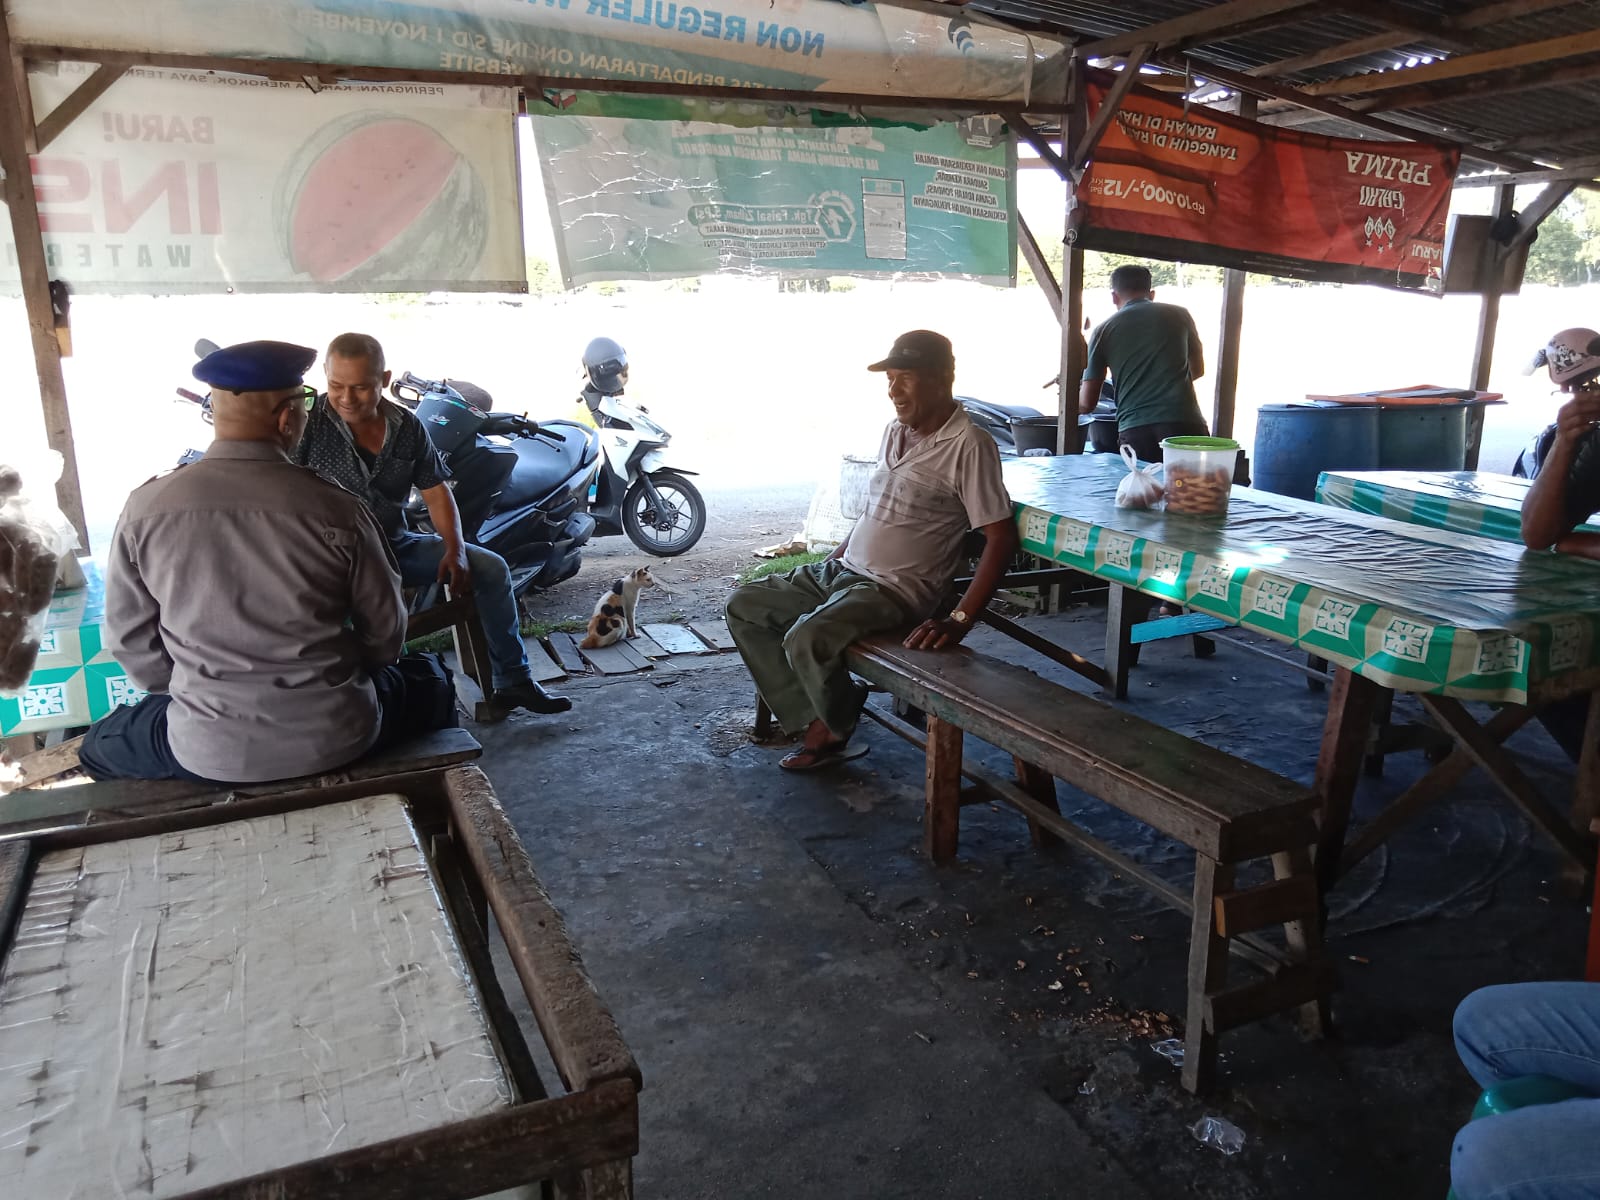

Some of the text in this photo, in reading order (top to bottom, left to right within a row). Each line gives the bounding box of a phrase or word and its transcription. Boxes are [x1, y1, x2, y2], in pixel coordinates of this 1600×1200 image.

[1145, 116, 1162, 130] DI
[1164, 119, 1217, 140] RAMAH
[1152, 133, 1167, 149] DI
[1169, 136, 1237, 161] TANGGUH
[1344, 150, 1432, 186] PRIMA
[1412, 244, 1442, 260] ARU!
